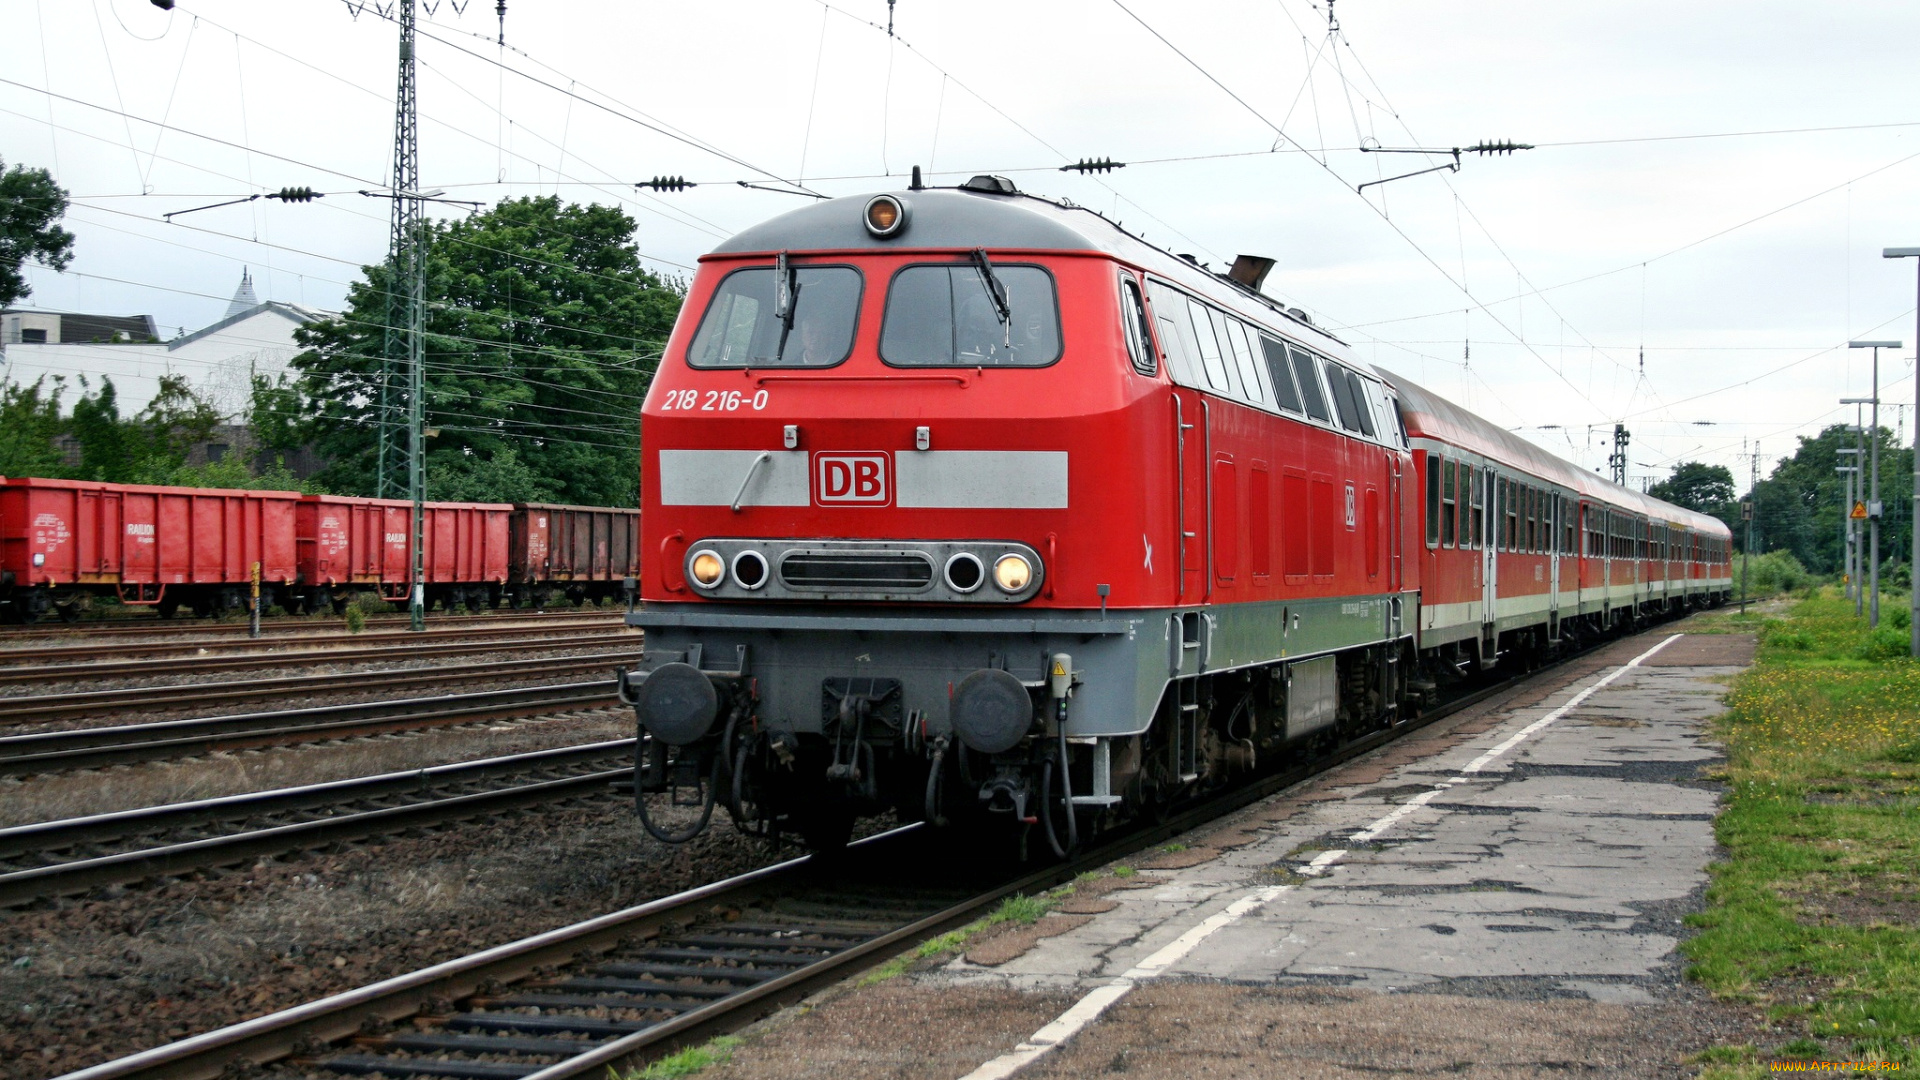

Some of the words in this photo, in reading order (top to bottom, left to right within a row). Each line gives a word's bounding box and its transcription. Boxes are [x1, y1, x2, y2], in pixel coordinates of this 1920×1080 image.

[661, 389, 698, 411] 218
[701, 389, 769, 411] 216-0
[824, 460, 881, 497] DB
[1346, 488, 1354, 522] DB
[127, 523, 155, 535] RAILION
